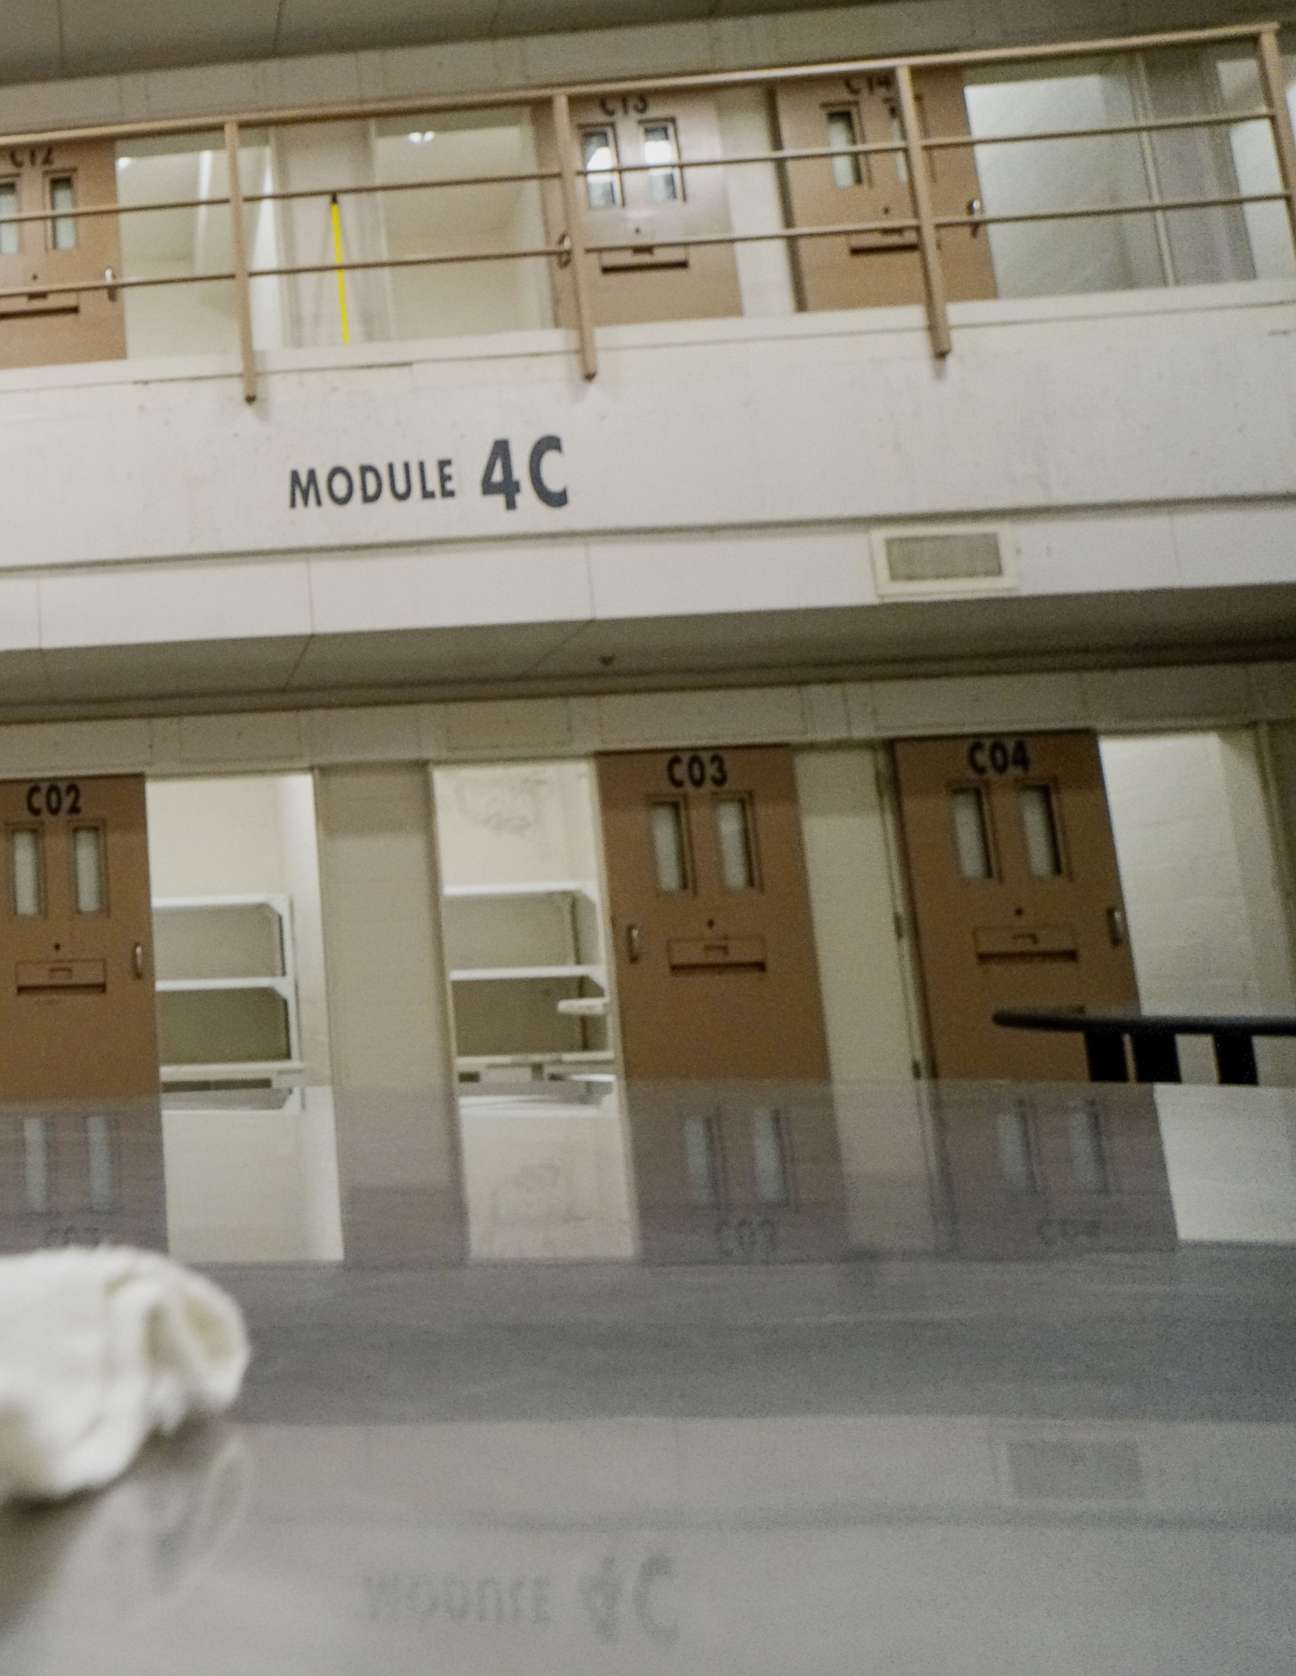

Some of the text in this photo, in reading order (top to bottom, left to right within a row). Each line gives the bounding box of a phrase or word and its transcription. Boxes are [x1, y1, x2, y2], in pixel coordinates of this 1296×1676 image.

[289, 434, 569, 511] MODULE 4C
[667, 752, 728, 788] C03
[967, 740, 1031, 776] C04
[27, 783, 82, 817] C02
